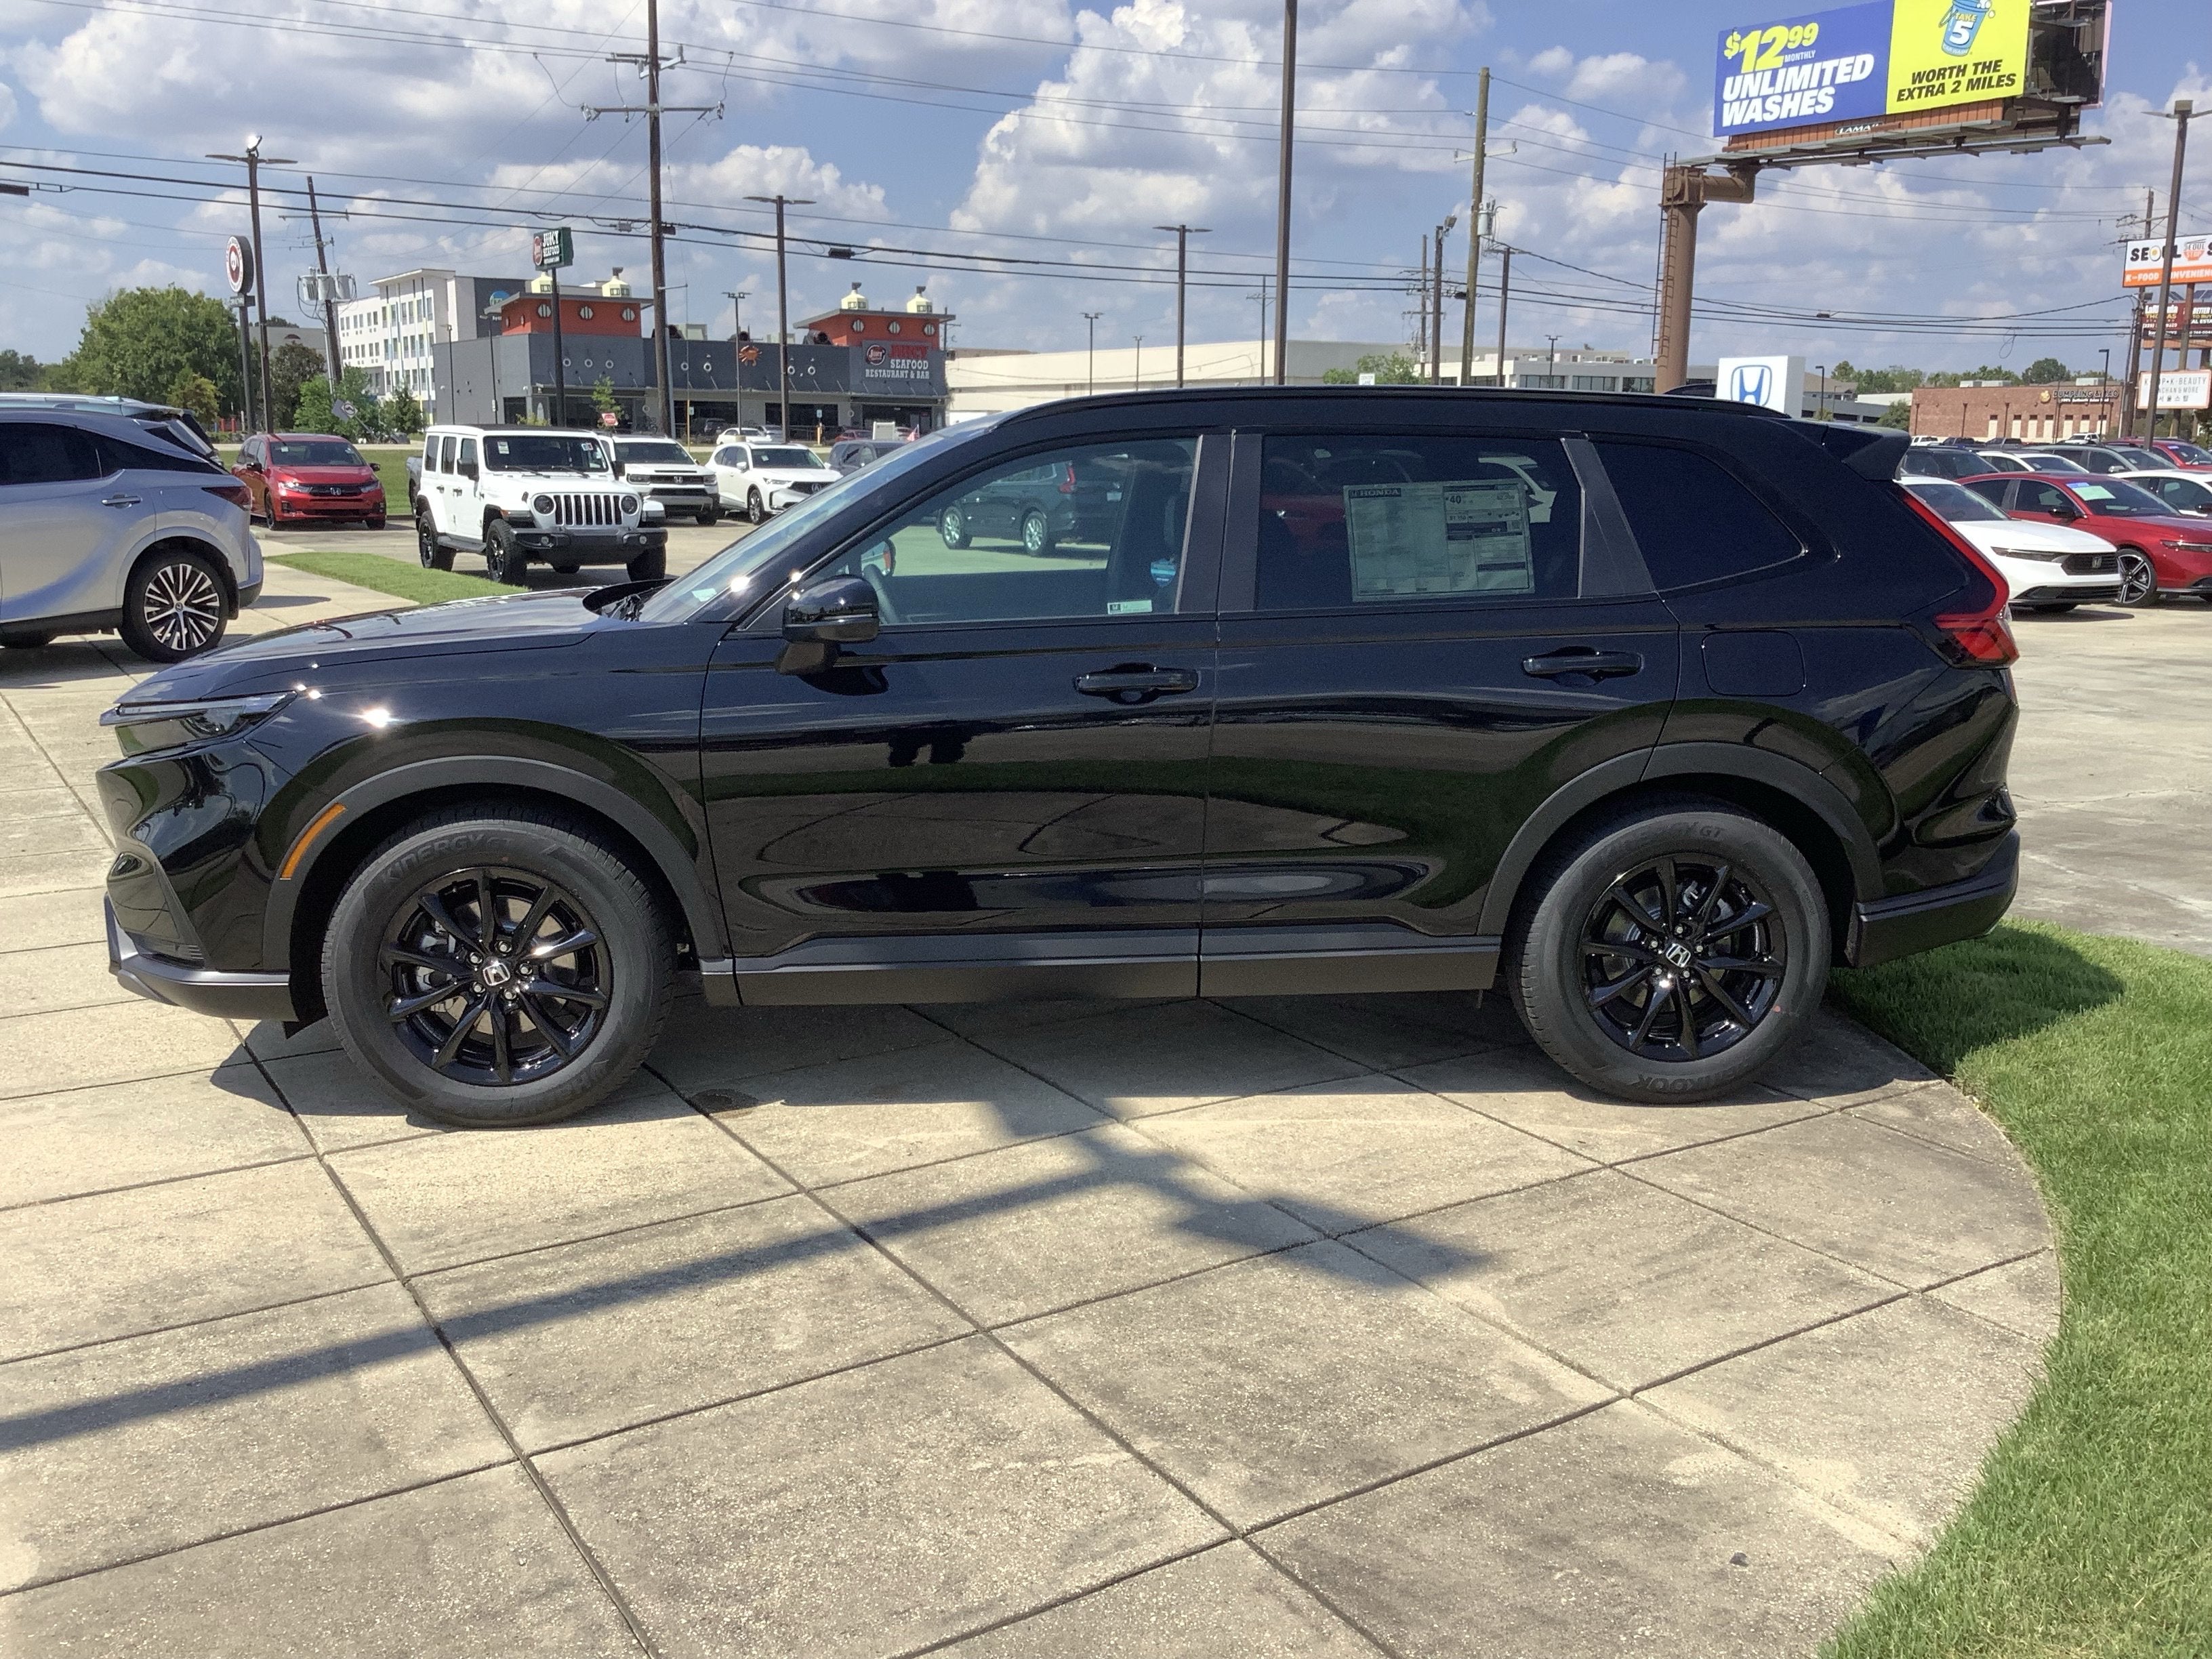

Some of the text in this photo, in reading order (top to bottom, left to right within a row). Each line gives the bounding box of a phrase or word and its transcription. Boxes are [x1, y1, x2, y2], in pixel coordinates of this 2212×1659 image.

[1955, 12, 1977, 22] TAKE
[1949, 20, 1975, 45] 5
[1784, 49, 1816, 62] MONTHLY
[1722, 54, 1875, 101] UNLIMITED
[1911, 59, 2003, 85] WORTH THE
[1896, 73, 2017, 102] EXTRA 2 MILES
[1722, 87, 1836, 127] WASHES
[543, 230, 559, 247] JUICY
[2130, 244, 2182, 262] SEOL
[890, 359, 929, 370] SEAFOOD
[865, 369, 930, 380] RESTAURANT & BAR
[1360, 487, 1400, 497] HONDA
[1450, 495, 1462, 504] 40
